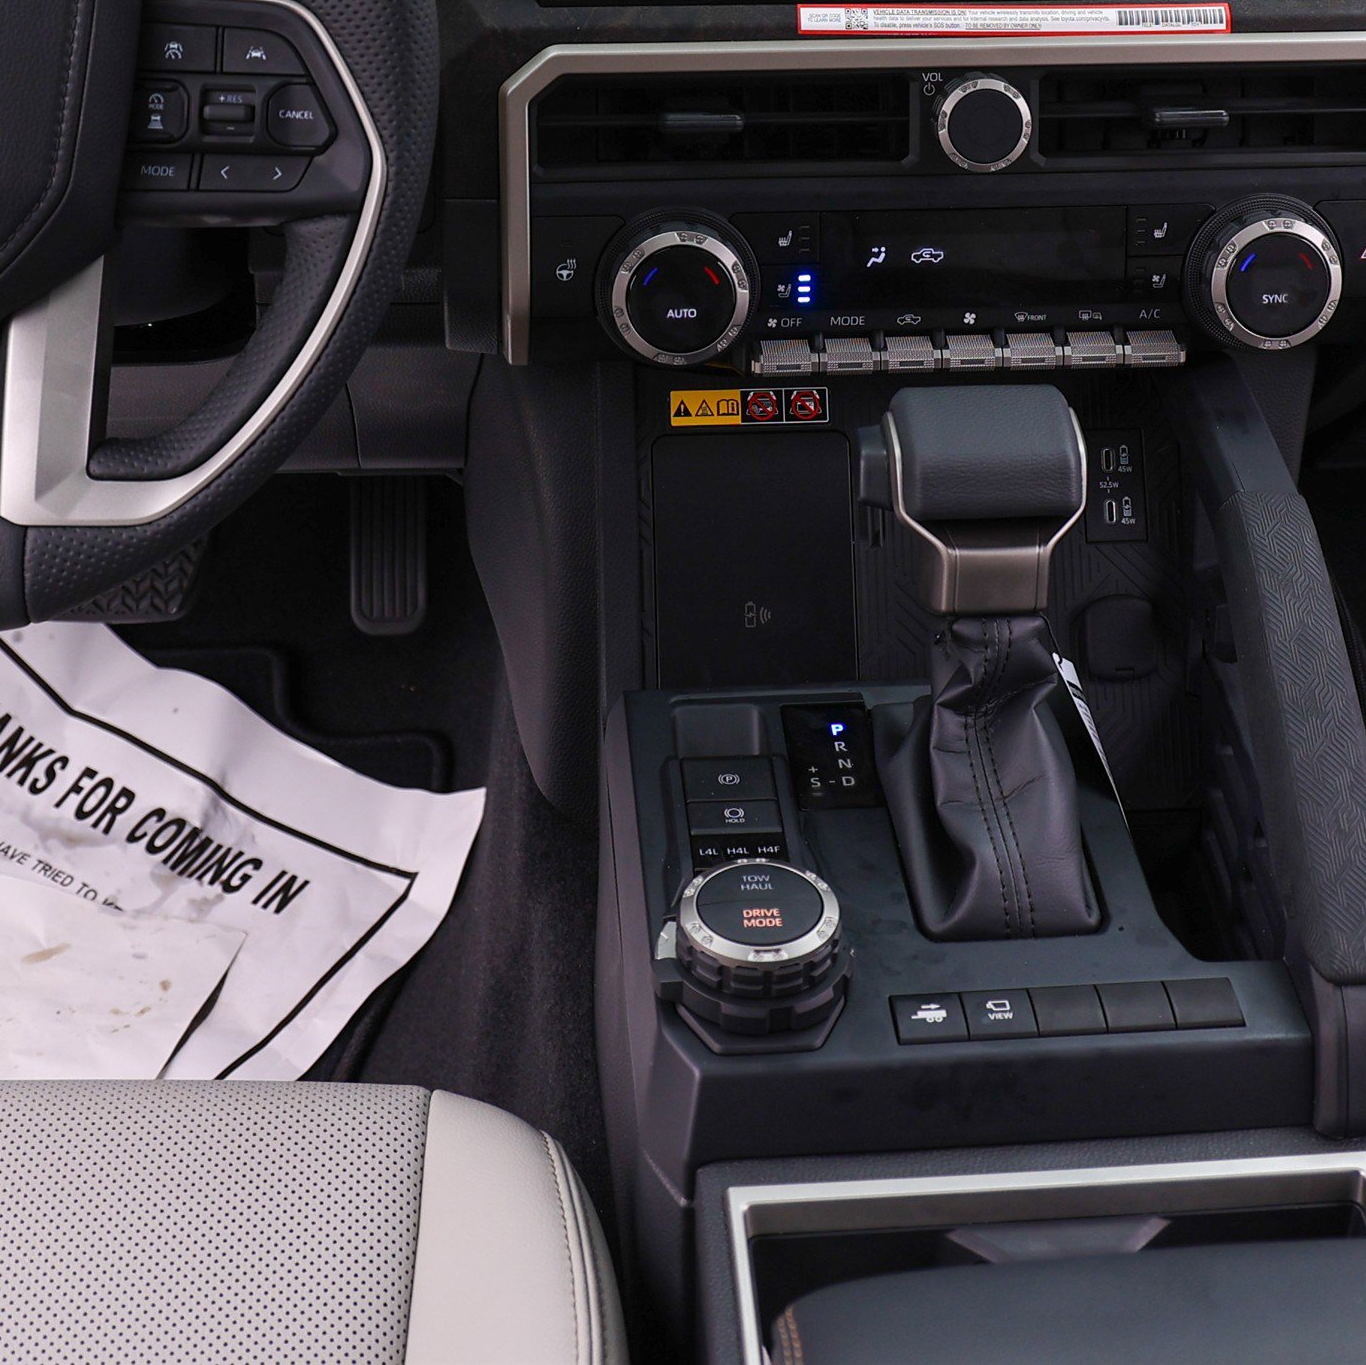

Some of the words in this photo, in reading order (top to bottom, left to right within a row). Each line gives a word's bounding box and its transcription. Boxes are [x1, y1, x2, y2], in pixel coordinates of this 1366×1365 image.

[921, 72, 944, 83] VOL
[279, 109, 314, 120] CANCEL
[140, 164, 176, 177] MODE
[1261, 292, 1290, 306] SYNC
[666, 308, 697, 320] AUTO
[780, 317, 803, 328] OFF
[830, 316, 866, 328] MODE
[1027, 313, 1047, 322] FRONT
[1139, 308, 1162, 320] A/C
[830, 723, 844, 736] P
[834, 741, 849, 752] R
[838, 758, 852, 769] N
[810, 777, 822, 788] S
[841, 776, 856, 787] D
[54, 766, 134, 837] FOR
[125, 806, 262, 895] COMING
[251, 868, 314, 916] IN
[698, 848, 719, 856] L4L
[726, 847, 750, 855] H4L
[757, 845, 781, 854] H4F
[31, 859, 75, 888] TRIED
[75, 882, 98, 902] TO
[740, 883, 775, 891] HAUL
[742, 907, 781, 918] DRIVE
[743, 917, 783, 928] MODE
[987, 1011, 1014, 1021] VIEW
